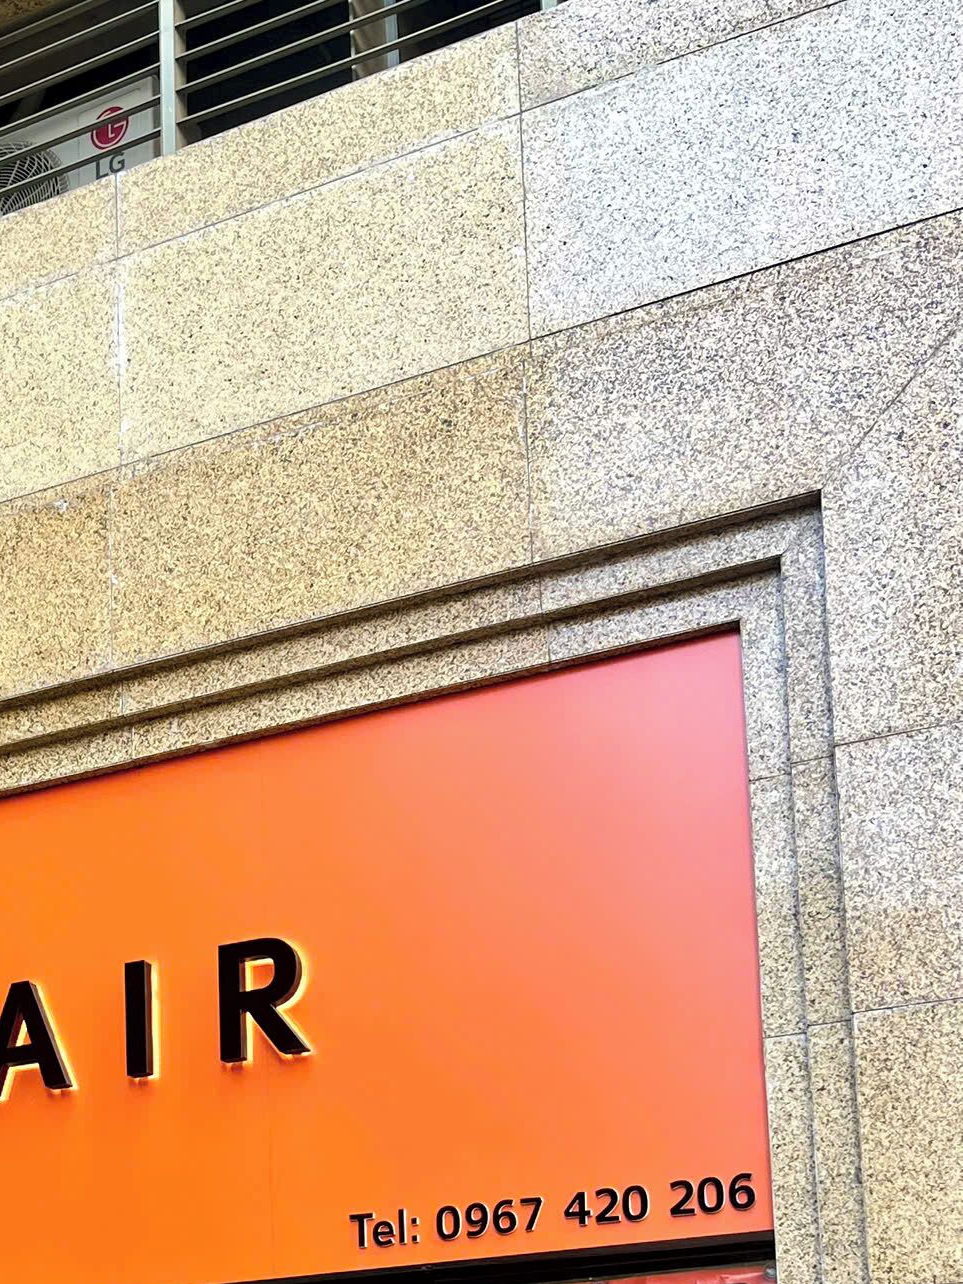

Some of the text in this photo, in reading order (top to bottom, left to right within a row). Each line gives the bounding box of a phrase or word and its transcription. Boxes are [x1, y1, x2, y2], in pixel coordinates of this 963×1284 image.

[95, 152, 126, 179] LG
[349, 1172, 757, 1249] Tel: 0967 420 206
